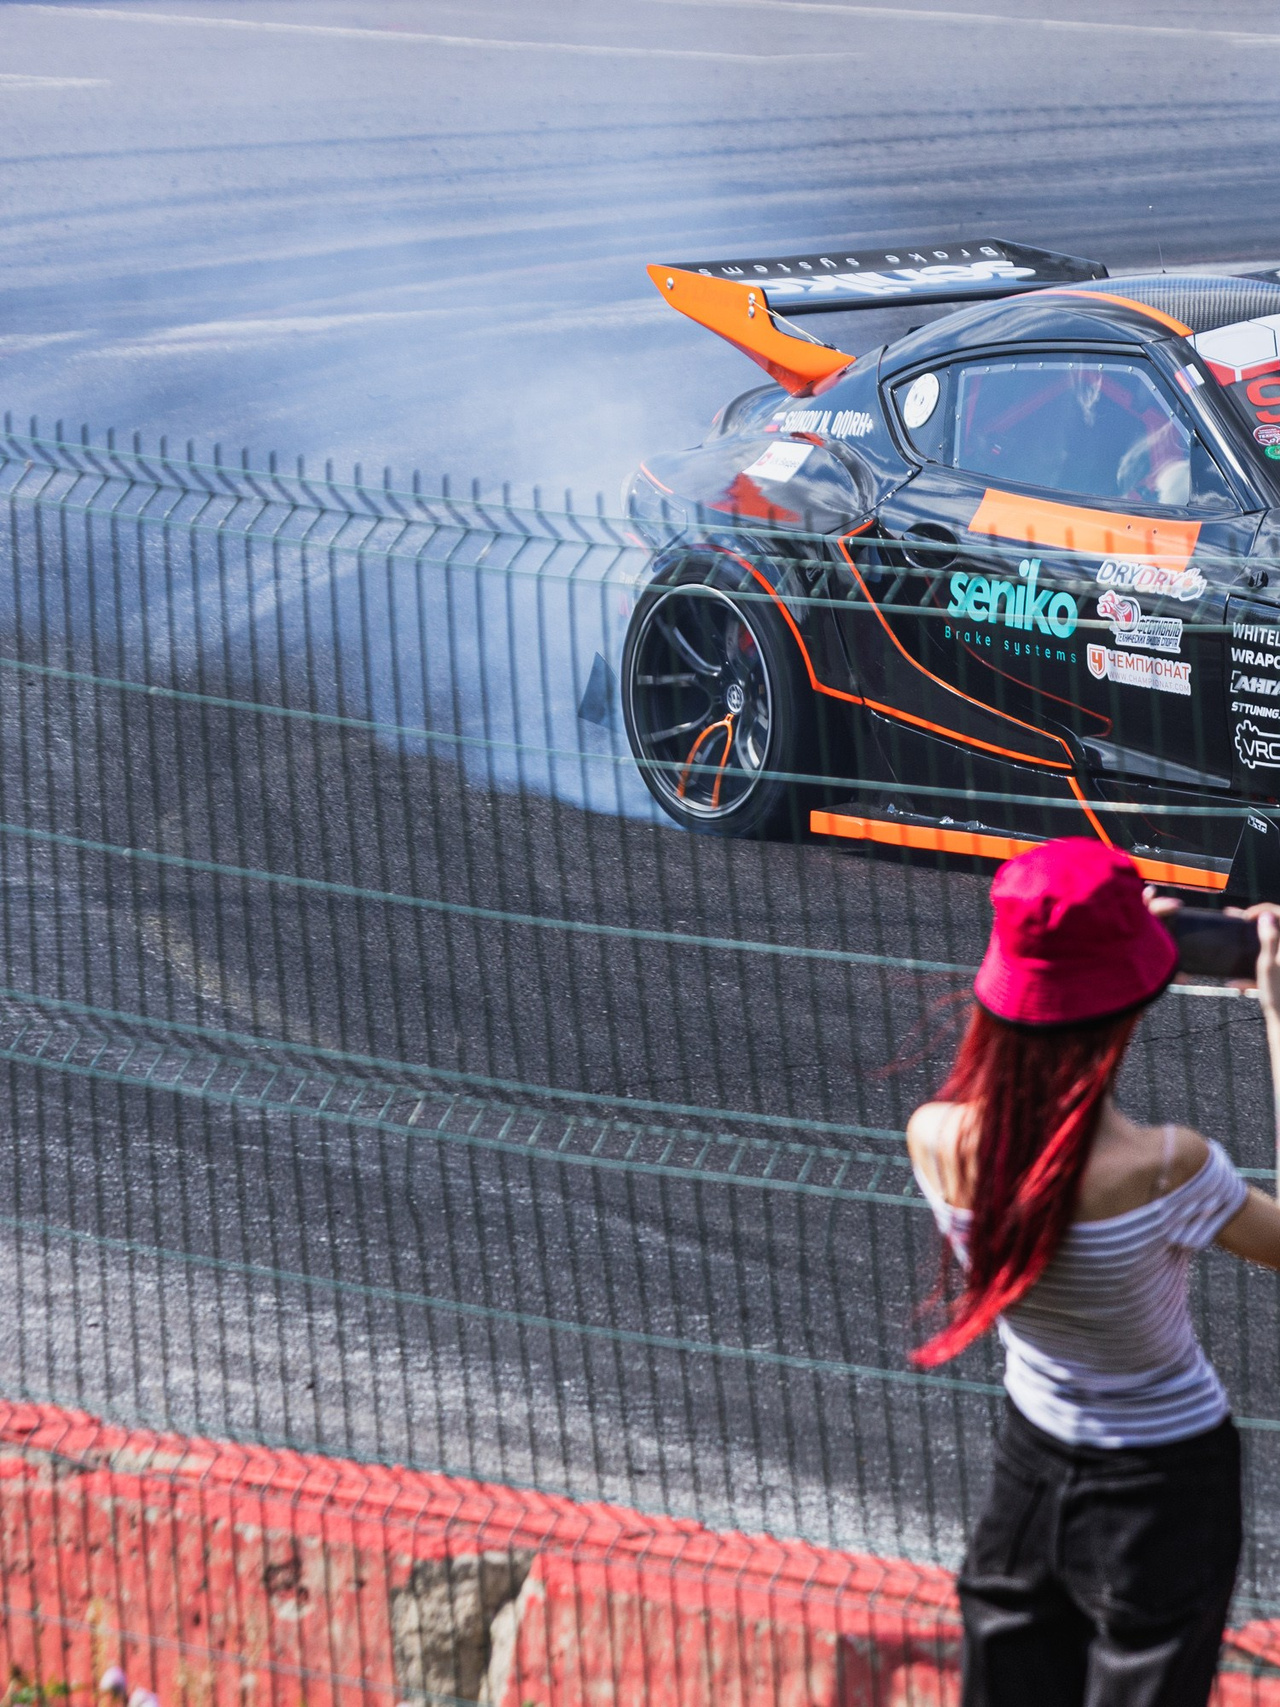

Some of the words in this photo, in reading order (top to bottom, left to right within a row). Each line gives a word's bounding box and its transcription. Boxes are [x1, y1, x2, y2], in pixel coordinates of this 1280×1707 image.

[698, 257, 861, 276] systems
[884, 246, 999, 264] Brake
[1099, 561, 1184, 594] DRYDRY
[947, 558, 1078, 639] seniko
[1137, 619, 1181, 637] ФЕСТИВАЛЬ
[944, 625, 992, 647] Brake
[1003, 639, 1077, 663] systems
[1108, 652, 1189, 680] ЧЕМПИОНАТ
[1109, 670, 1190, 693] WWW.CHAMPIONAT.COM
